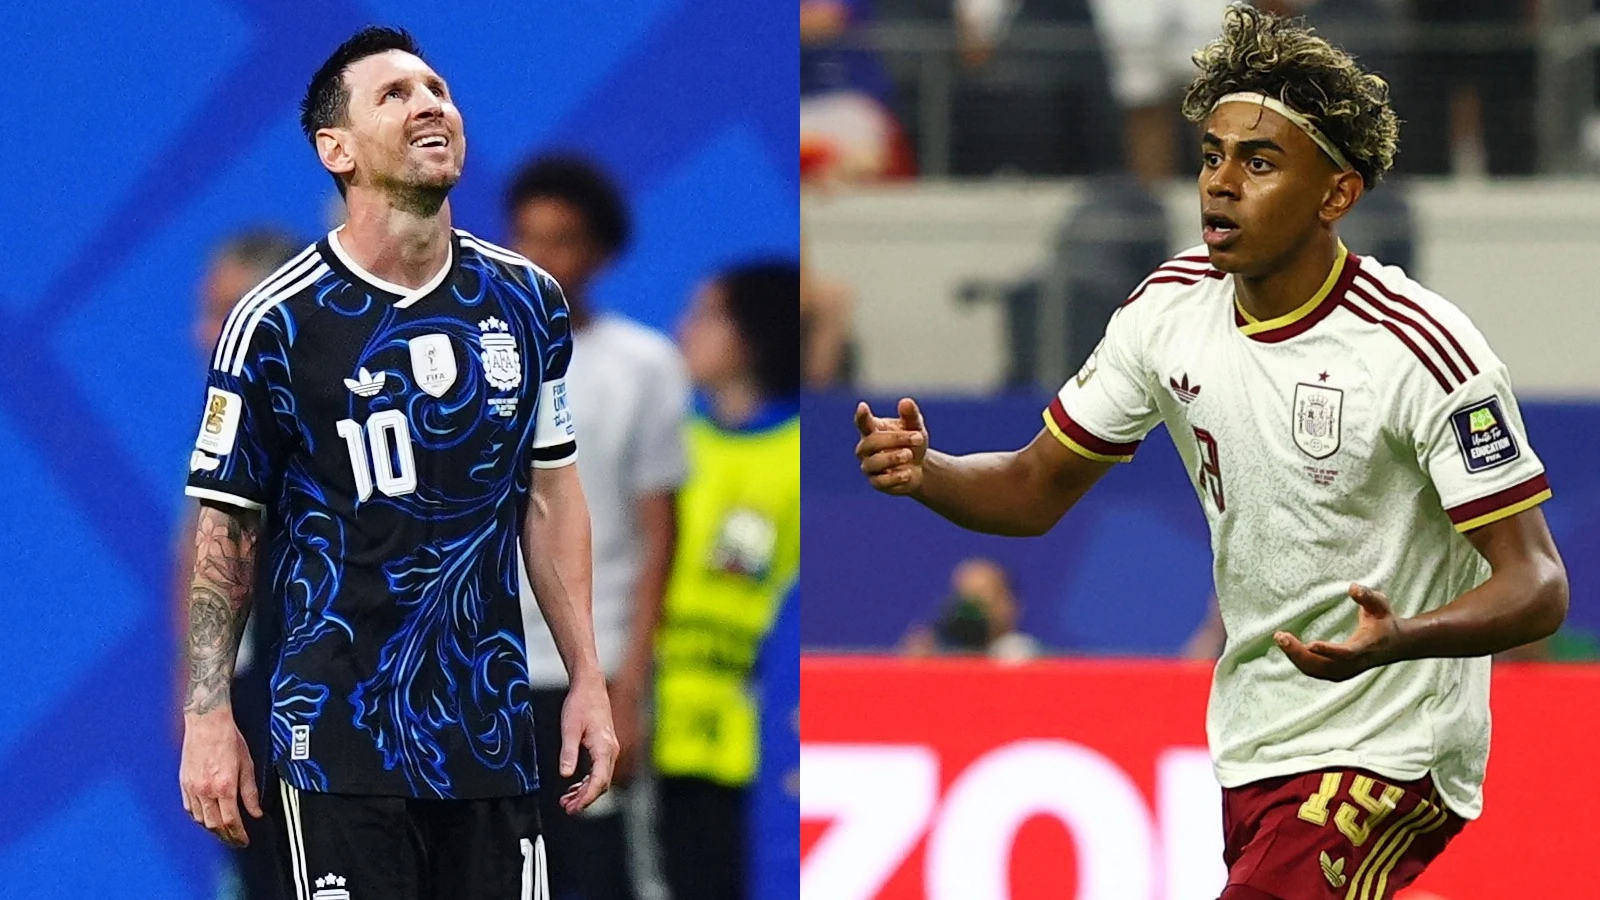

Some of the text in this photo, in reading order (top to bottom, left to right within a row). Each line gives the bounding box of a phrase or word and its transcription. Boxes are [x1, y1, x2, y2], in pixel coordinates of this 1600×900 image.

[426, 372, 445, 381] FIFA
[336, 409, 417, 503] 10
[1470, 436, 1510, 459] EDUCATION
[1485, 452, 1502, 463] FIFA
[1297, 772, 1405, 847] 19
